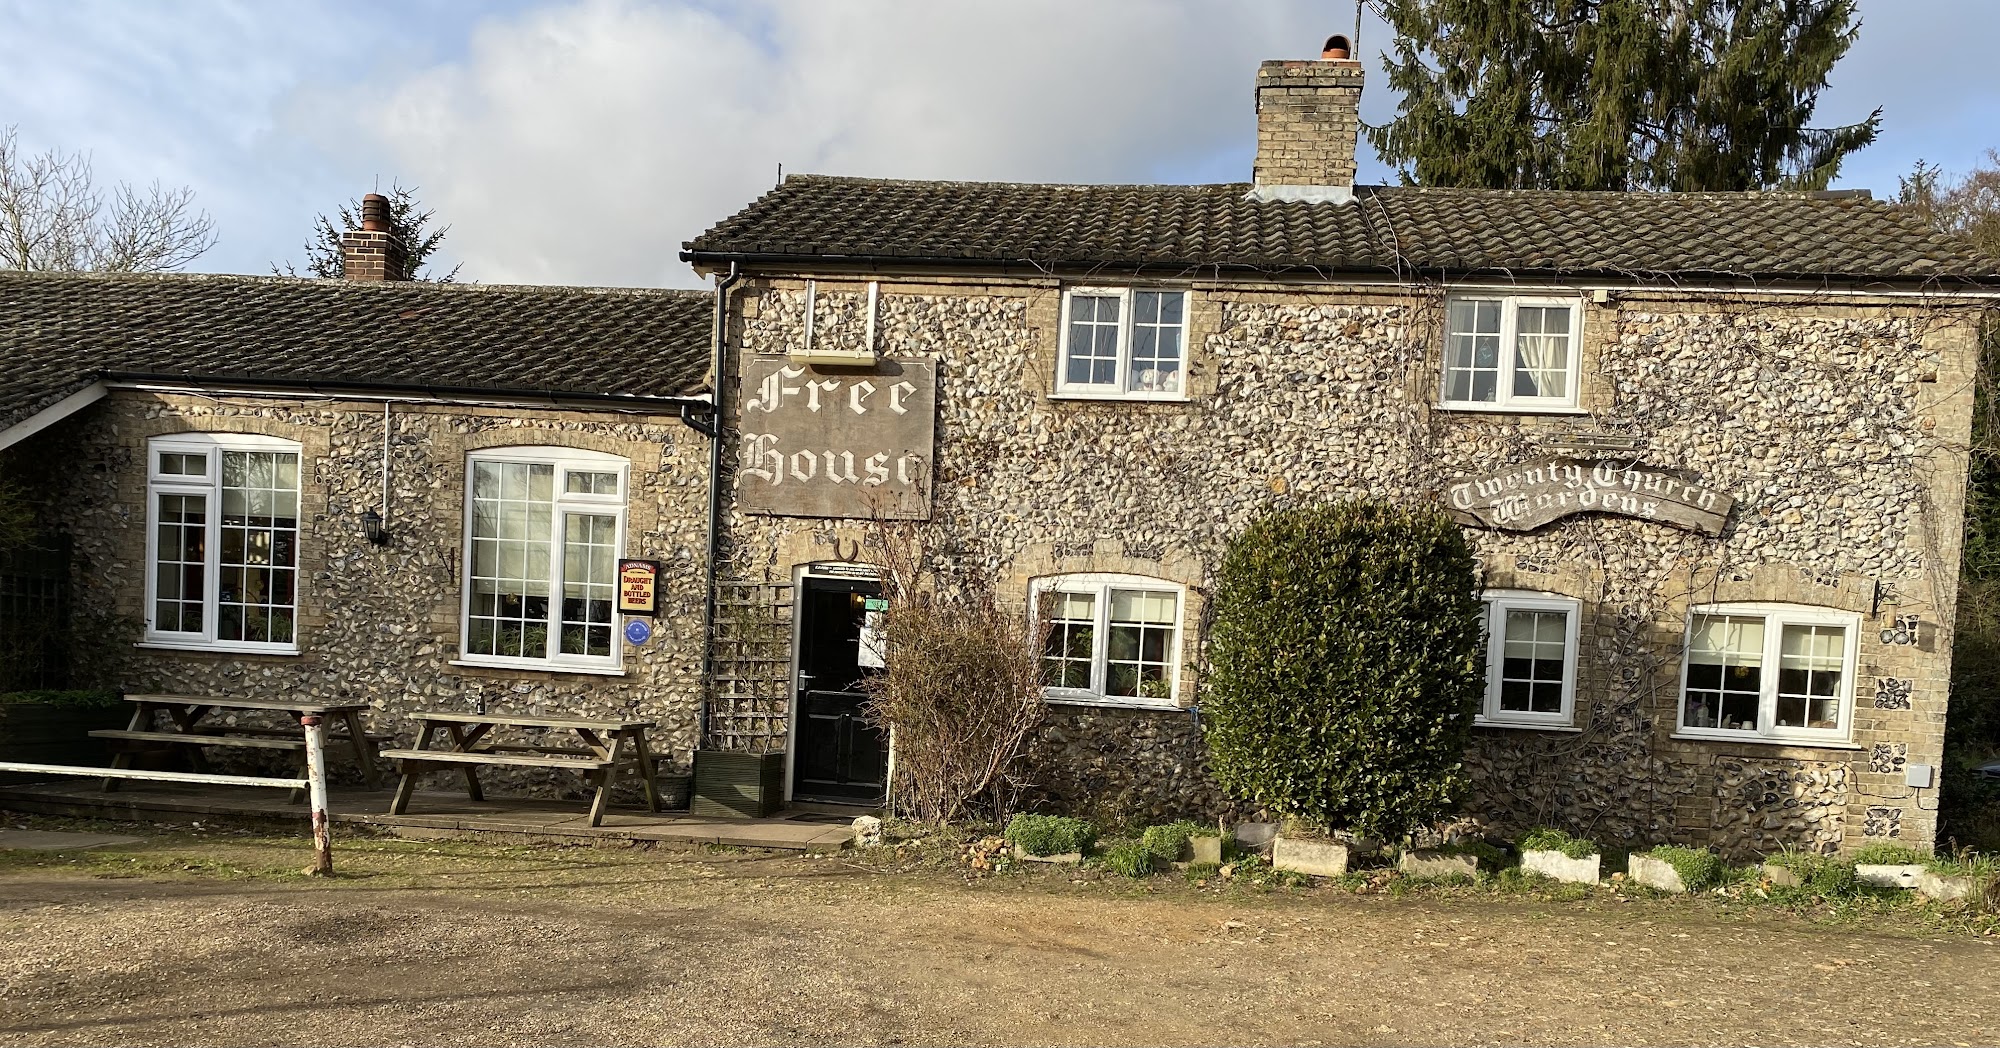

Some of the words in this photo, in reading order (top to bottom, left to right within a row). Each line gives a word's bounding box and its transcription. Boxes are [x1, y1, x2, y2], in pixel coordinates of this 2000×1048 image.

[747, 365, 917, 415] Free
[740, 433, 921, 486] House
[1450, 460, 1582, 509] Twenty
[1592, 460, 1716, 511] Church
[1490, 481, 1659, 525] Wardens
[623, 576, 653, 584] DRAUGHT
[626, 562, 651, 570] ADNAMS
